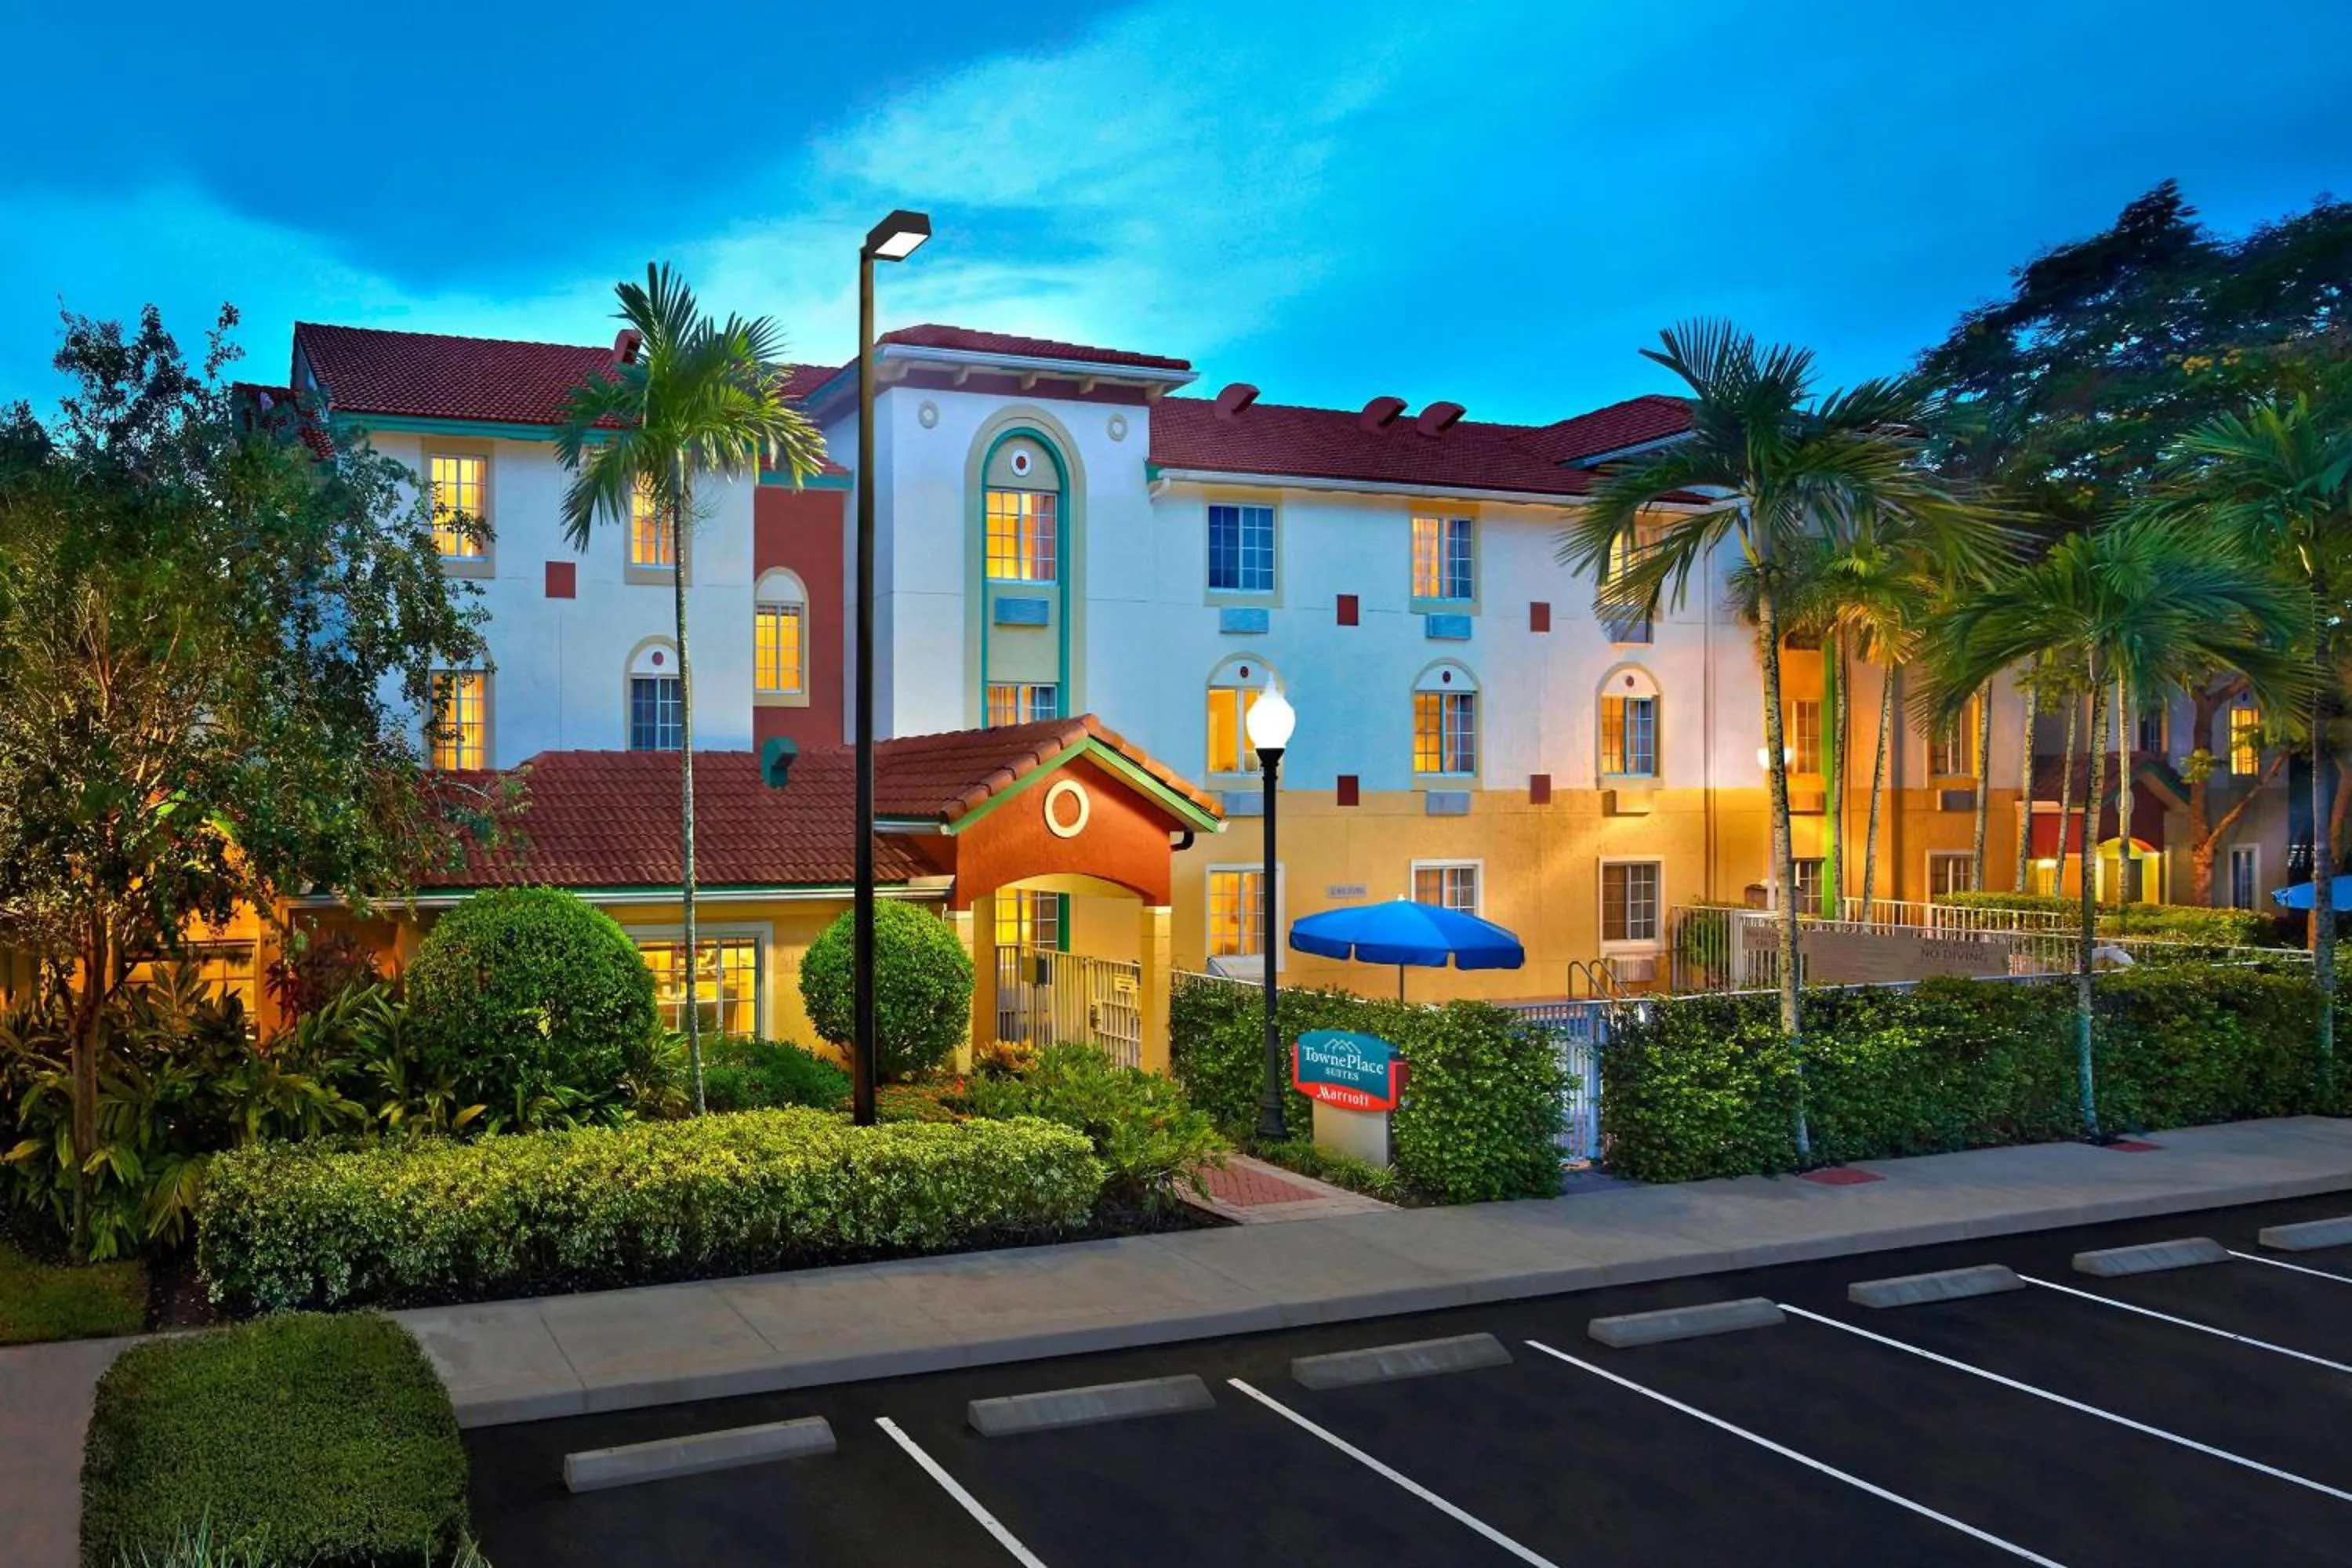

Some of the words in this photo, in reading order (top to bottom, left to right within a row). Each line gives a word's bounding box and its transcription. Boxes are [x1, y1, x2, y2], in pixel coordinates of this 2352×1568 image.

[1921, 946, 1939, 957] NO
[1943, 949, 1988, 963] DIVING
[1302, 1045, 1384, 1075] TownePlace
[1325, 1067, 1359, 1081] SUITES
[1317, 1085, 1368, 1106] Marriott
